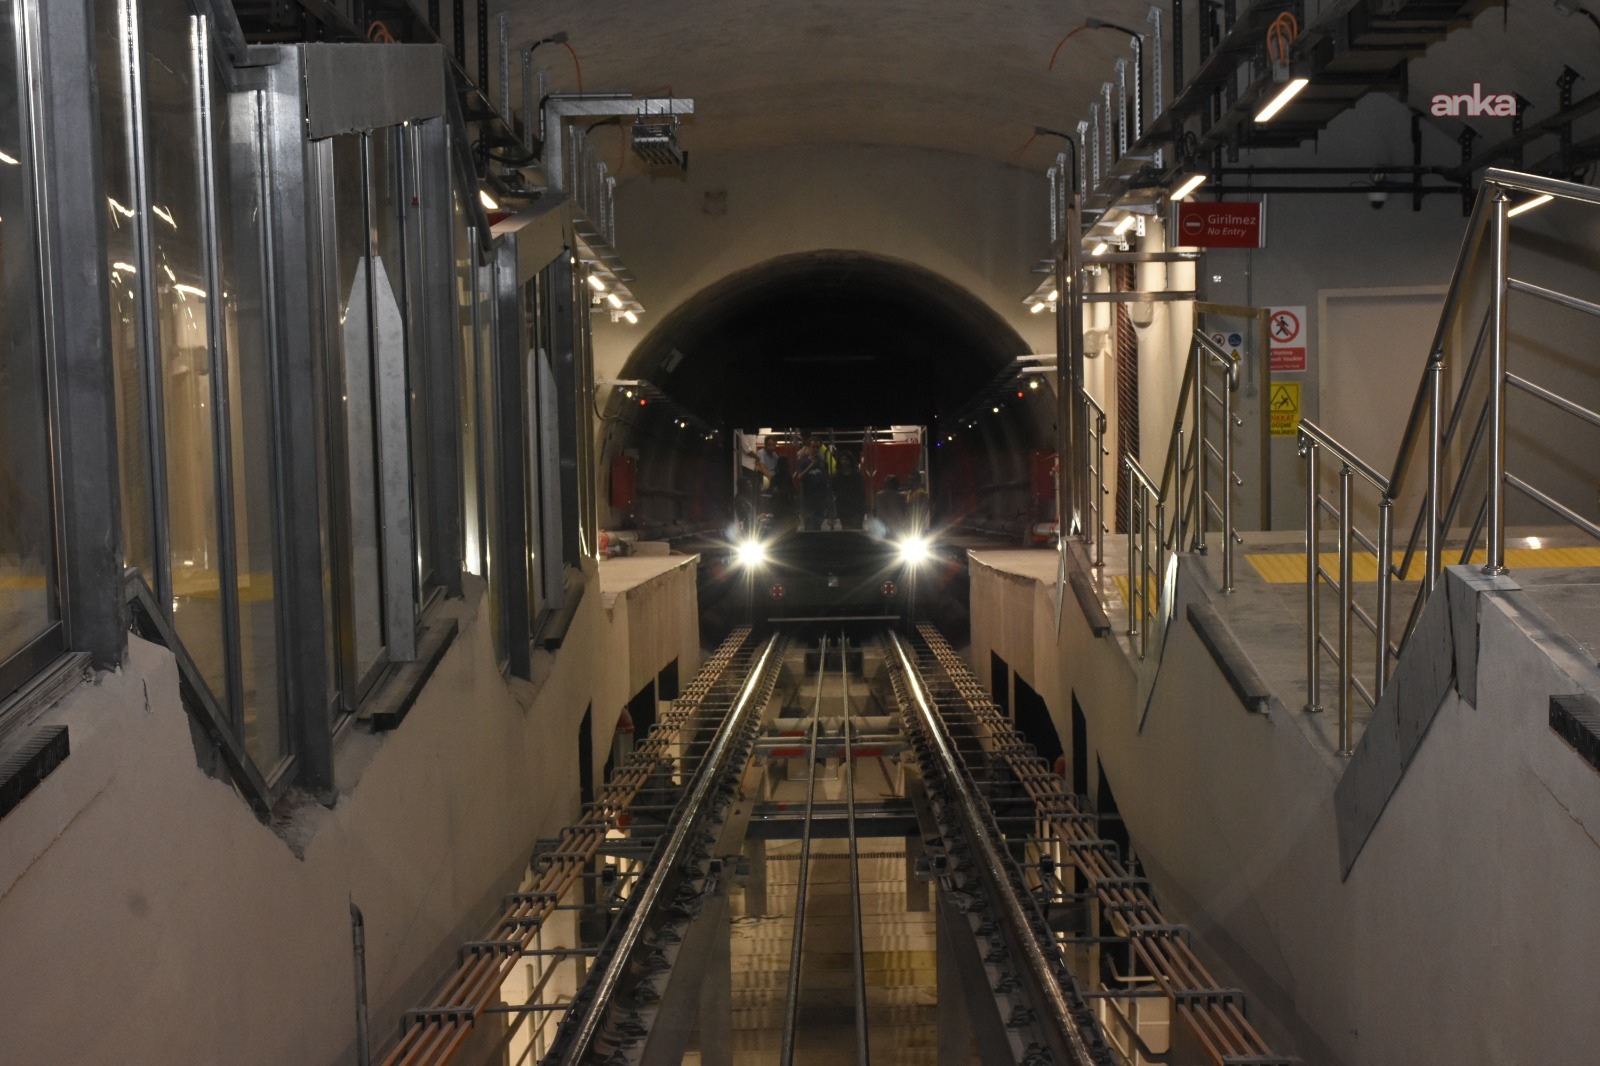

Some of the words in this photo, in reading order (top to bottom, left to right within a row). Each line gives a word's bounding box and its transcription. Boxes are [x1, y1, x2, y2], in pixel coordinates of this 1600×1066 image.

[1208, 214, 1256, 225] Girilmez
[1208, 227, 1220, 235] No
[1222, 227, 1246, 238] Entry
